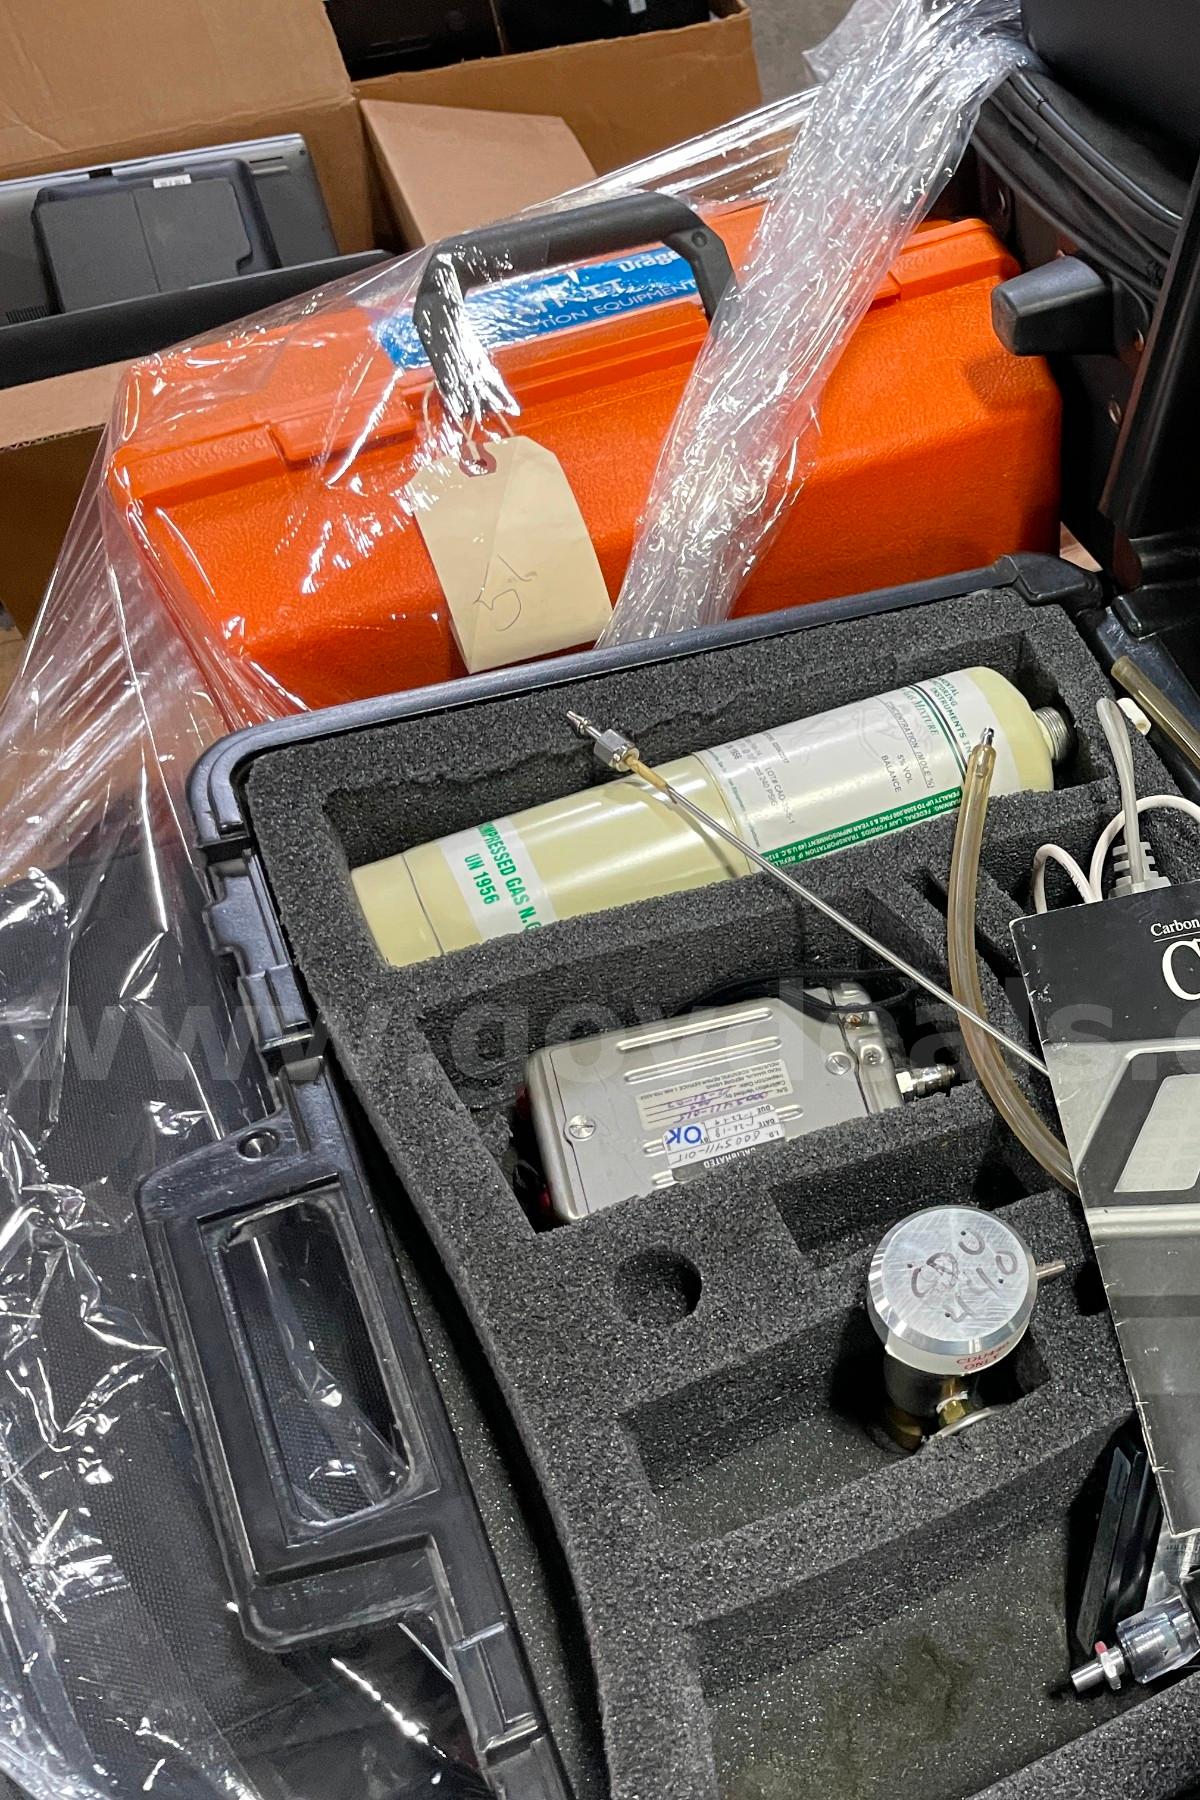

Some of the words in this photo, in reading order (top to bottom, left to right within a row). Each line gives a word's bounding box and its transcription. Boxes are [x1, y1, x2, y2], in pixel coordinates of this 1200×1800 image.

[617, 250, 682, 273] Dräge
[593, 279, 697, 314] EQUIPMENT
[881, 755, 902, 793] BALANCE
[904, 765, 914, 785] VOL
[464, 853, 477, 871] UN
[472, 871, 500, 905] 1956
[505, 874, 530, 906] GAS
[1150, 917, 1200, 937] Carbon
[756, 1104, 771, 1113] DUE
[666, 1125, 702, 1144] OK
